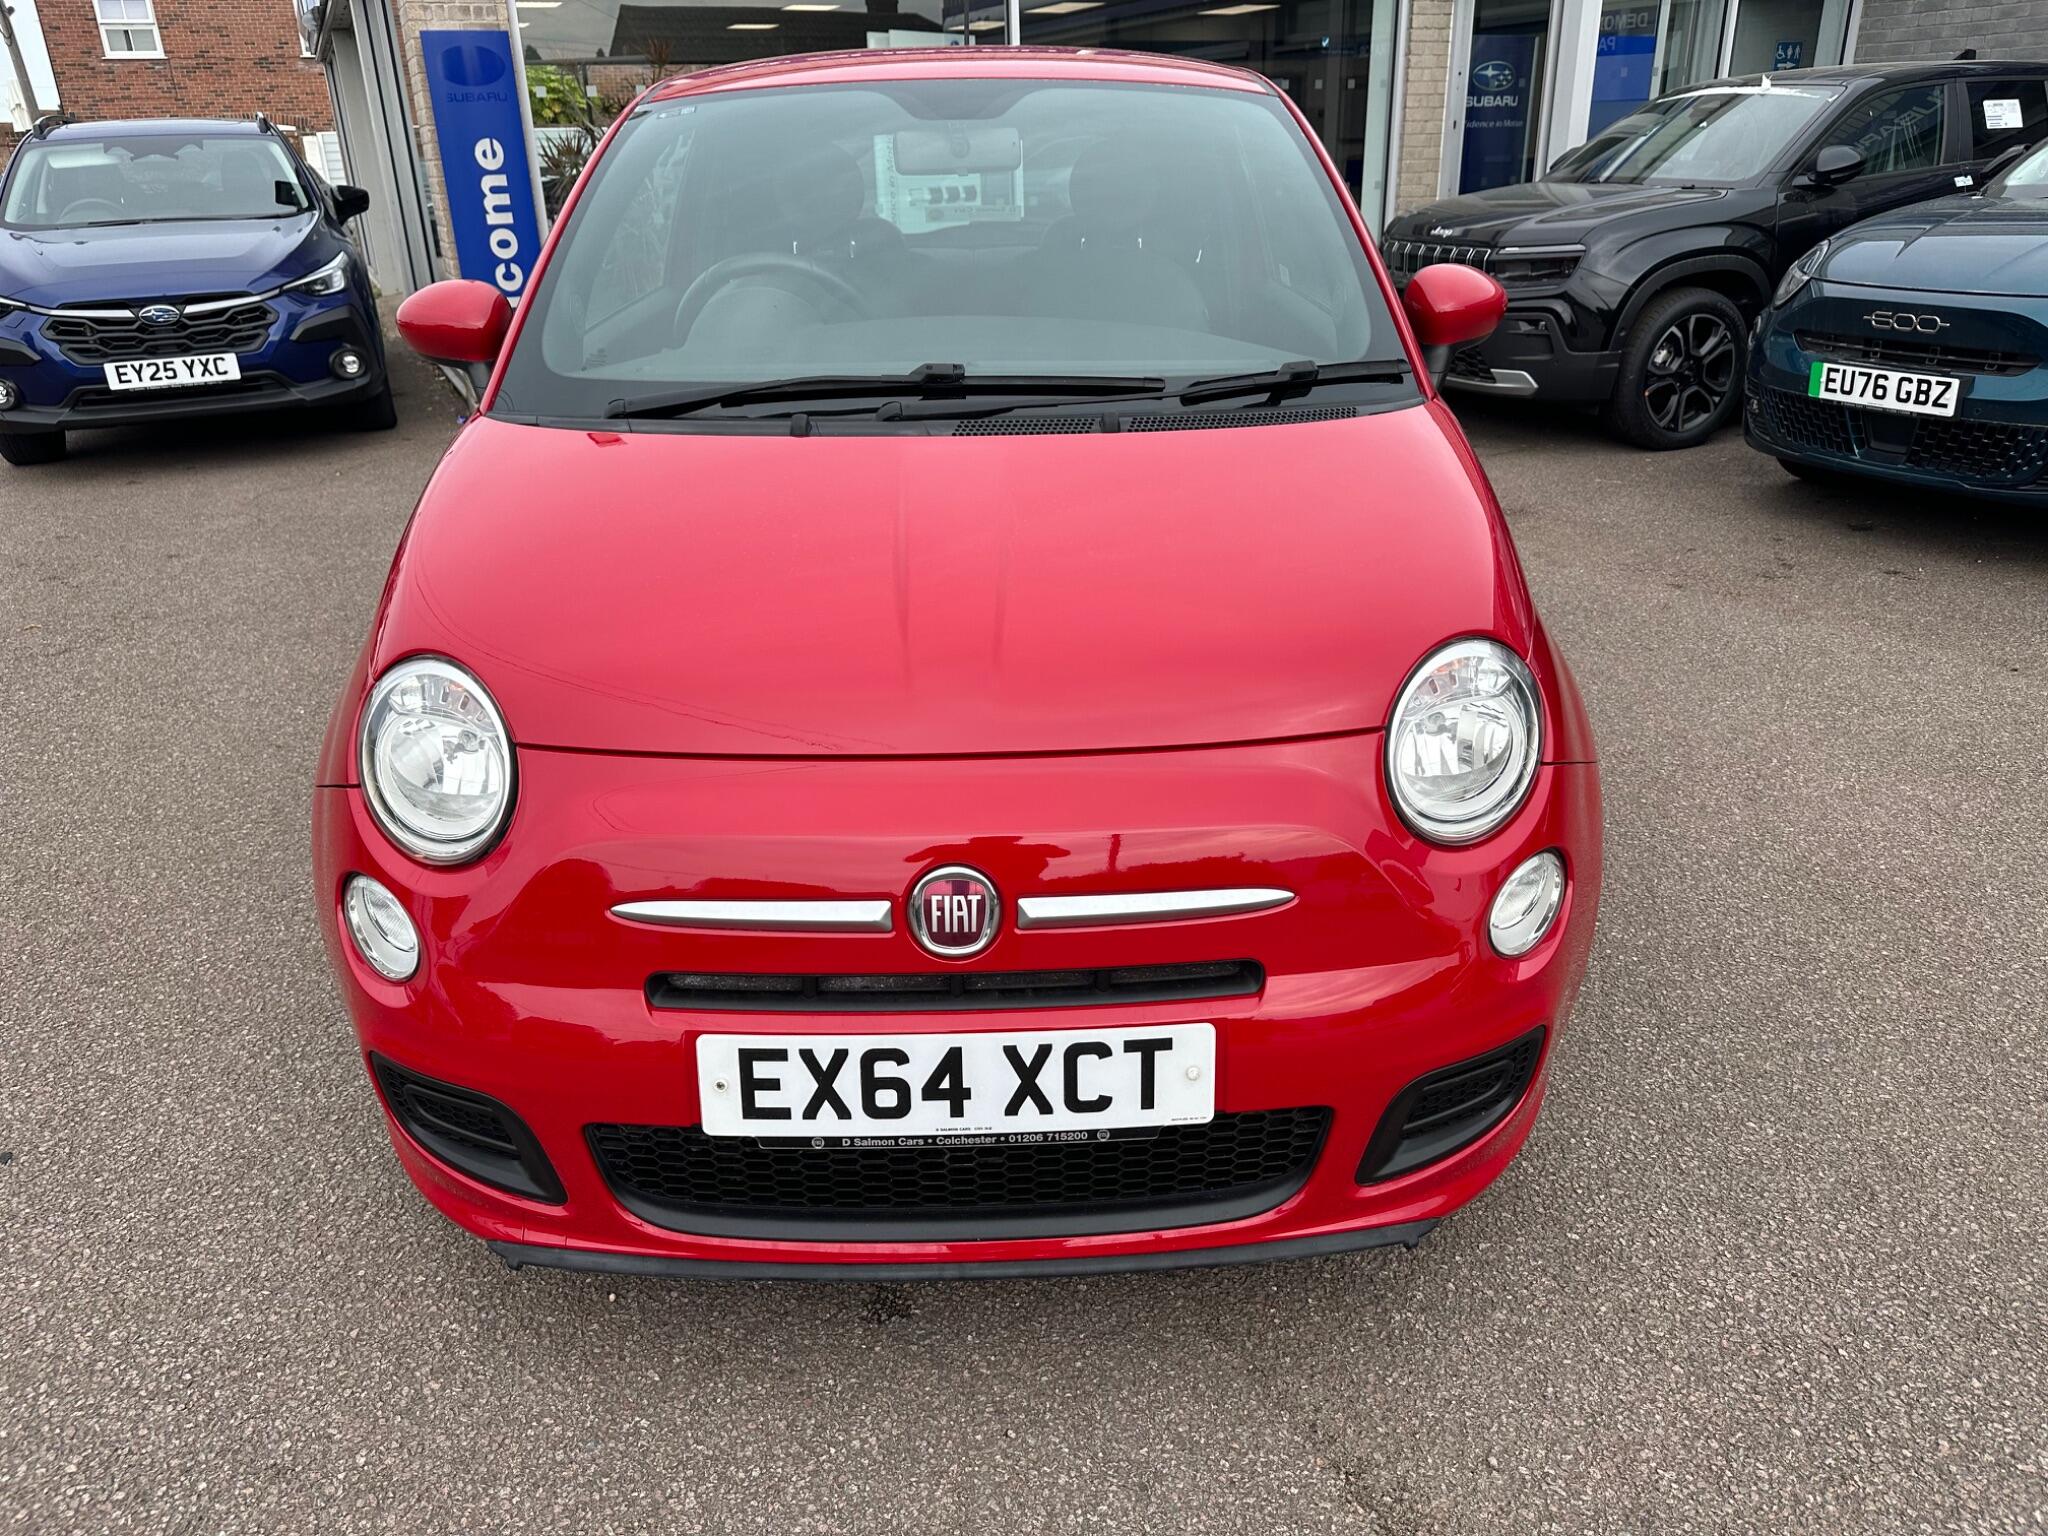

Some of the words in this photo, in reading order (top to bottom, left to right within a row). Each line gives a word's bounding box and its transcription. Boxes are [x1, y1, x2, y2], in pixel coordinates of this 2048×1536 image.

[447, 92, 508, 103] SUBARU
[1466, 95, 1519, 107] SUBARU
[474, 138, 523, 308] come
[1870, 311, 1942, 333] 600
[114, 361, 178, 384] EY25
[182, 357, 229, 378] YXC
[1824, 367, 1889, 400] EU76
[1895, 377, 1952, 409] GBZ
[931, 895, 981, 933] FIAT
[738, 1046, 972, 1120] EX64
[1002, 1037, 1173, 1116] XCT
[842, 1138, 851, 1147] D
[854, 1138, 895, 1146] Salmon
[898, 1137, 924, 1146] Cars
[936, 1135, 997, 1145] Colchester
[1008, 1134, 1044, 1143] 01206
[1047, 1131, 1088, 1141] 715200
